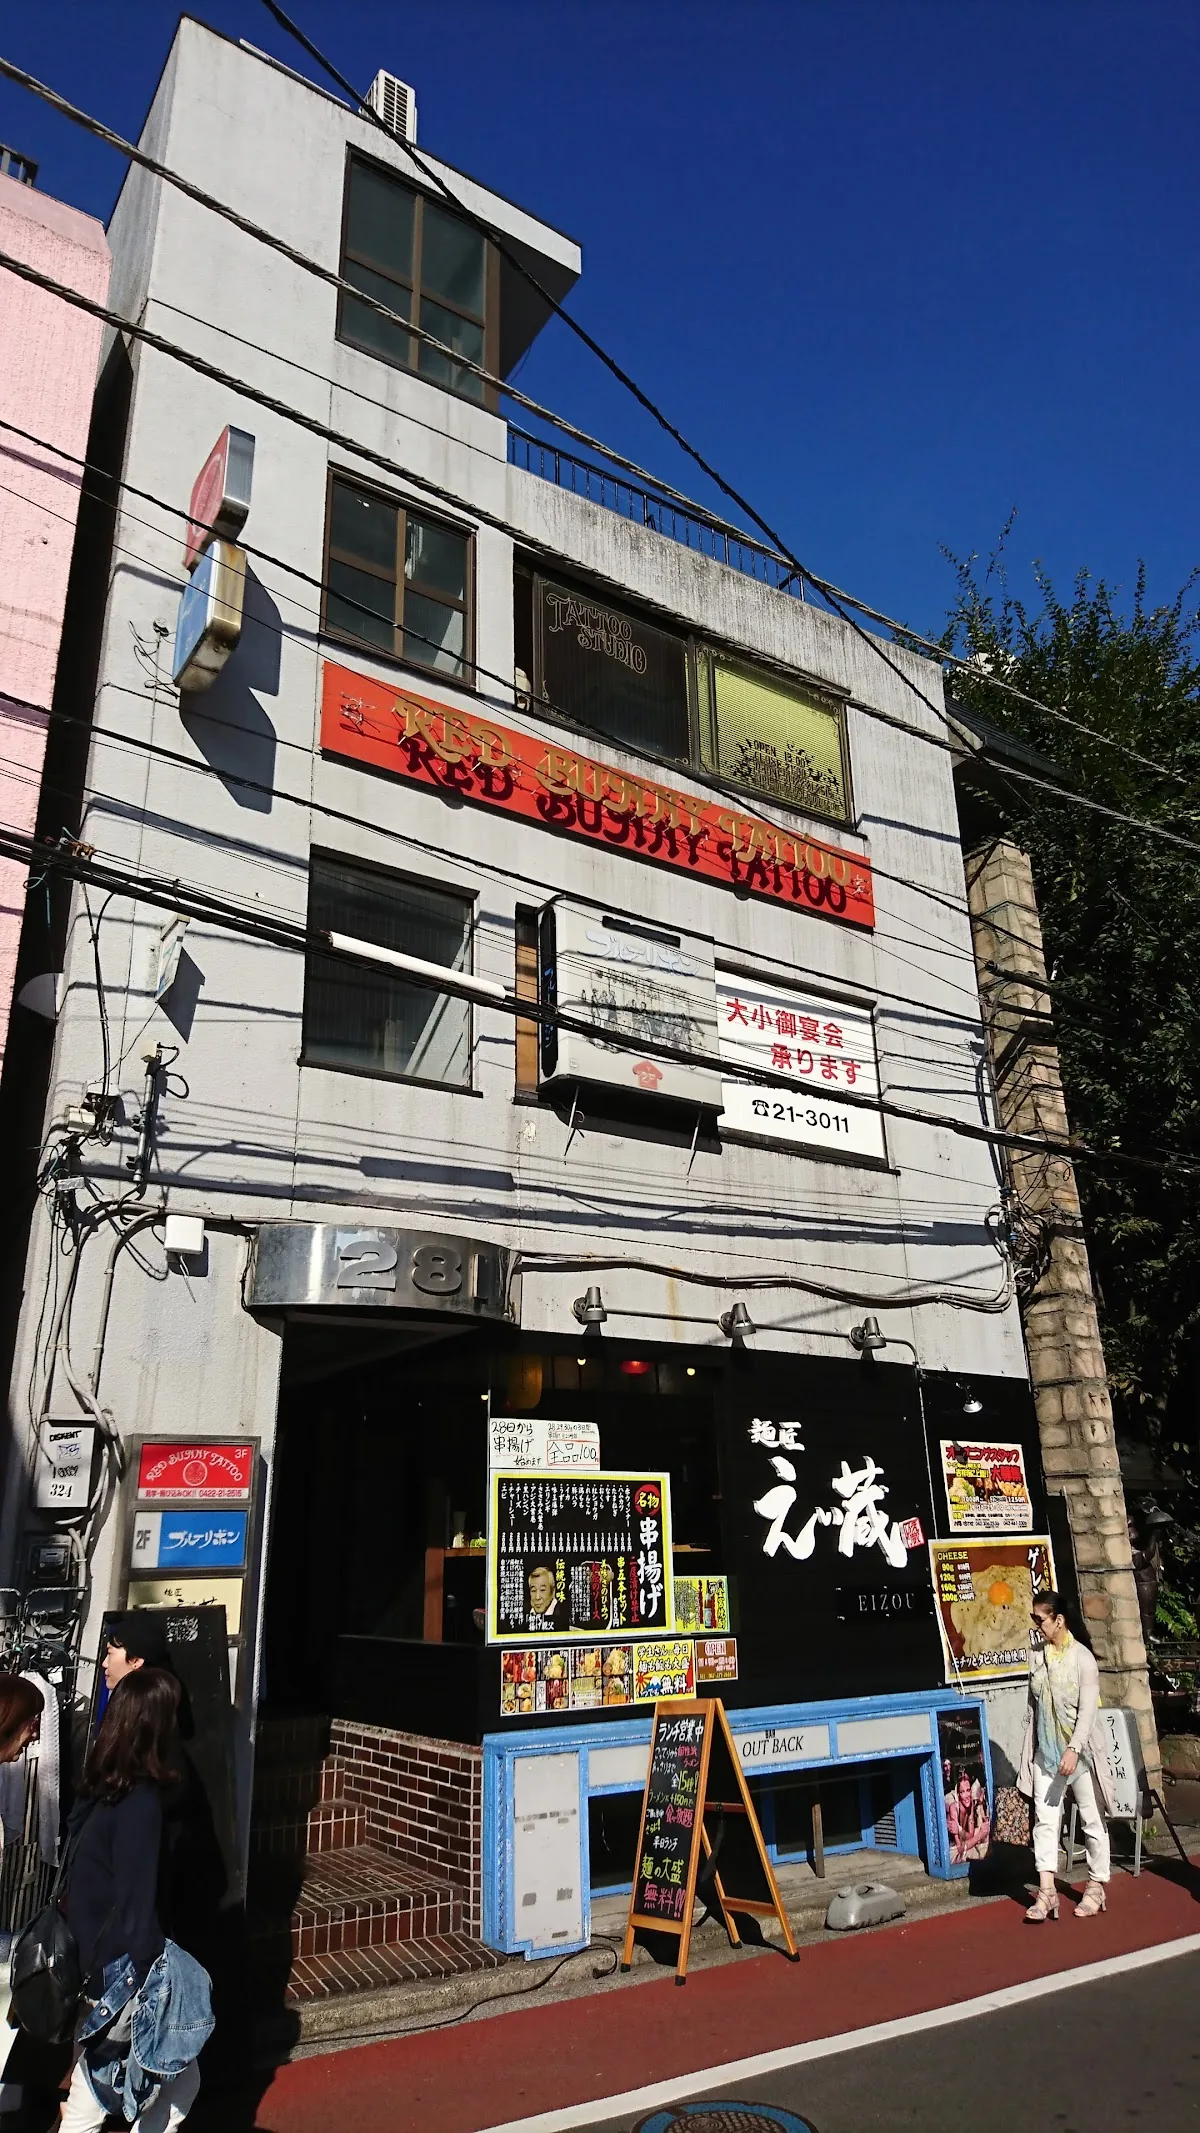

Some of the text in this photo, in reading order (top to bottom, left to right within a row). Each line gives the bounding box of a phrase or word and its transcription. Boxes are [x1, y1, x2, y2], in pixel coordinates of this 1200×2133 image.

[546, 593, 631, 640] TATTOO
[577, 627, 647, 675] STUDIO
[753, 740, 776, 757] OPEN
[393, 695, 512, 767] RED
[535, 748, 711, 836] BUNNY
[717, 812, 851, 886] TATTOO
[726, 997, 844, 1049] 大小御宴会
[771, 1043, 861, 1085] 承ります
[772, 1103, 849, 1133] 21-3011
[235, 1449, 248, 1459] 3F
[494, 1437, 534, 1453] 串揚げ
[146, 1461, 167, 1481] RED
[210, 1452, 243, 1482] TATTOO
[50, 1484, 72, 1497] 324
[637, 1491, 659, 1508] 名物
[136, 1530, 151, 1549] 2F
[163, 1529, 240, 1549] ブルーリボン
[937, 1551, 969, 1561] CHEESE
[637, 1516, 664, 1619] 串揚げ
[942, 1562, 954, 1571] 90g
[555, 1558, 566, 1603] 伝統の味
[940, 1572, 955, 1582] 120g
[941, 1583, 956, 1592] 160g
[858, 1593, 915, 1612] EIZOU
[942, 1593, 958, 1602] 200g
[673, 1643, 689, 1656] 毎日
[704, 1641, 727, 1656] OPEN
[661, 1672, 688, 1696] 無料
[659, 1718, 704, 1743] ランチ営業中
[742, 1735, 804, 1758] OUT BACK
[652, 1835, 679, 1852] 平日ランチ
[640, 1852, 685, 1885] 麺の大盛
